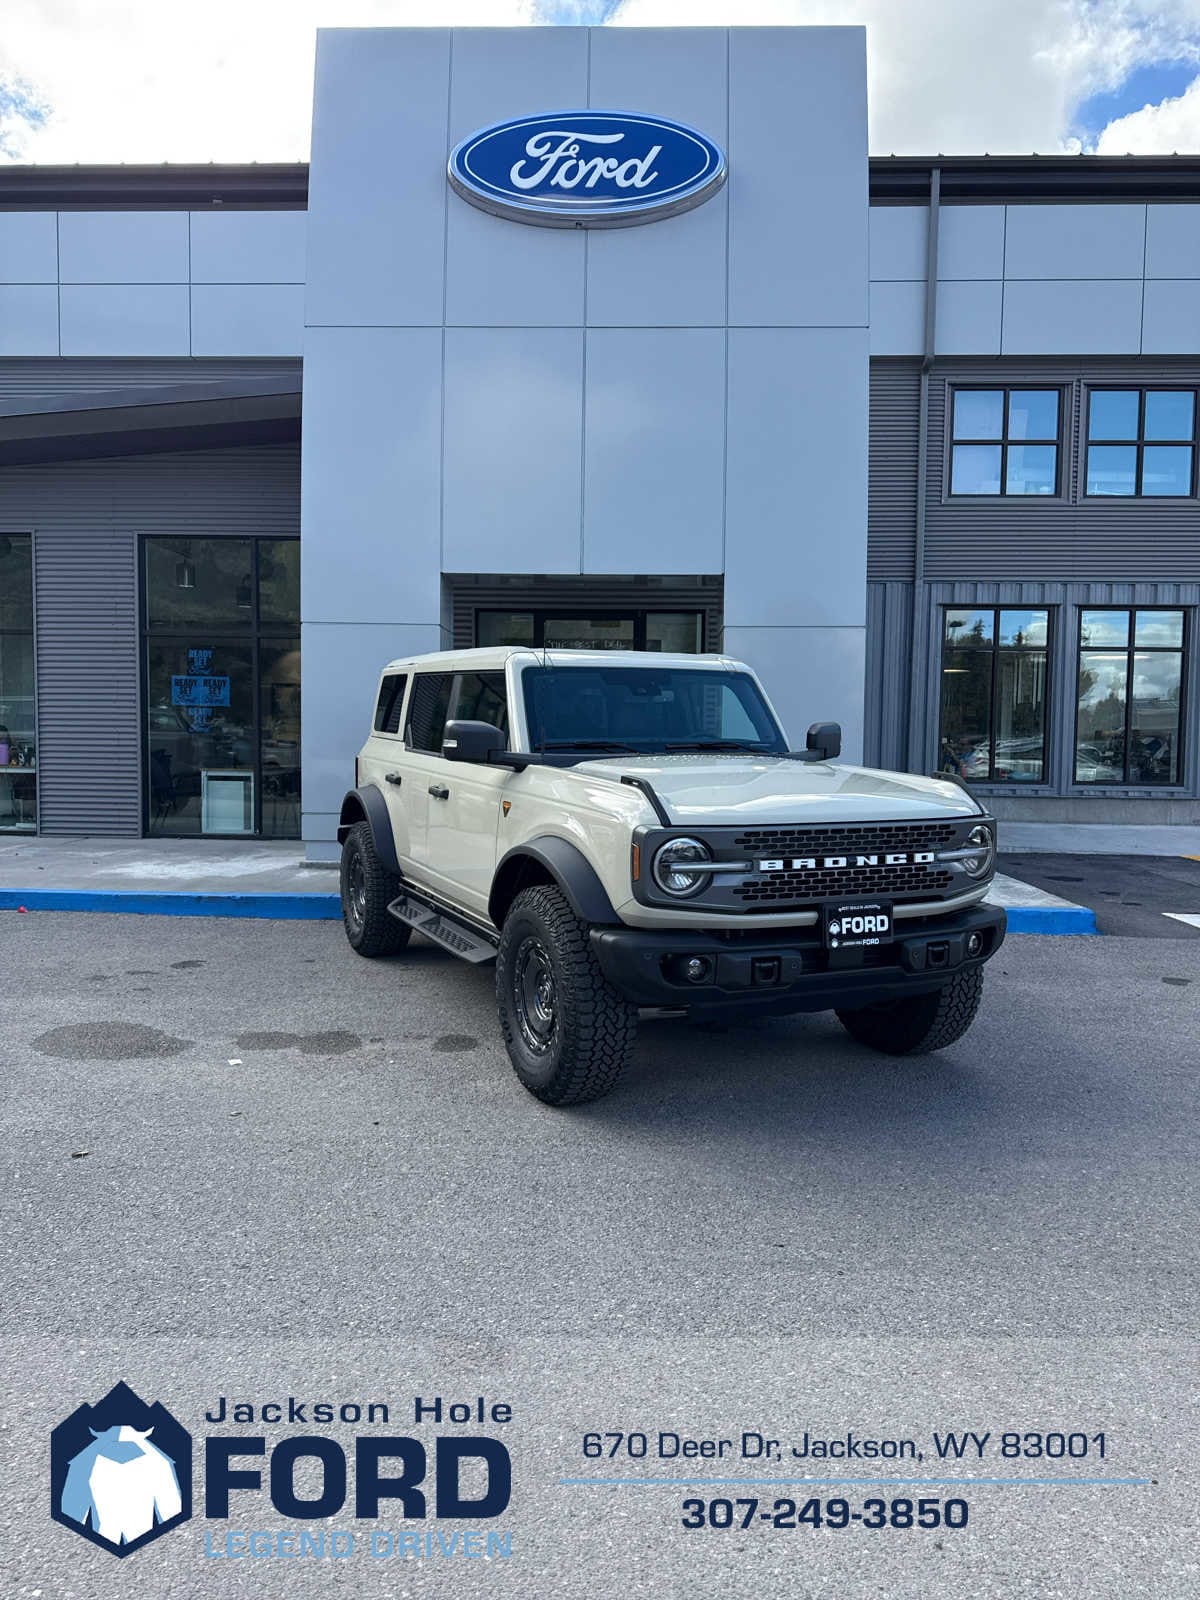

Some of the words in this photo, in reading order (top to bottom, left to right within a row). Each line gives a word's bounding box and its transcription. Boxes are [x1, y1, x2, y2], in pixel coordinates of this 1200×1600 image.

[510, 131, 662, 189] Ford
[188, 649, 213, 658] READY
[759, 852, 935, 871] BRONCO
[841, 915, 888, 934] FORD
